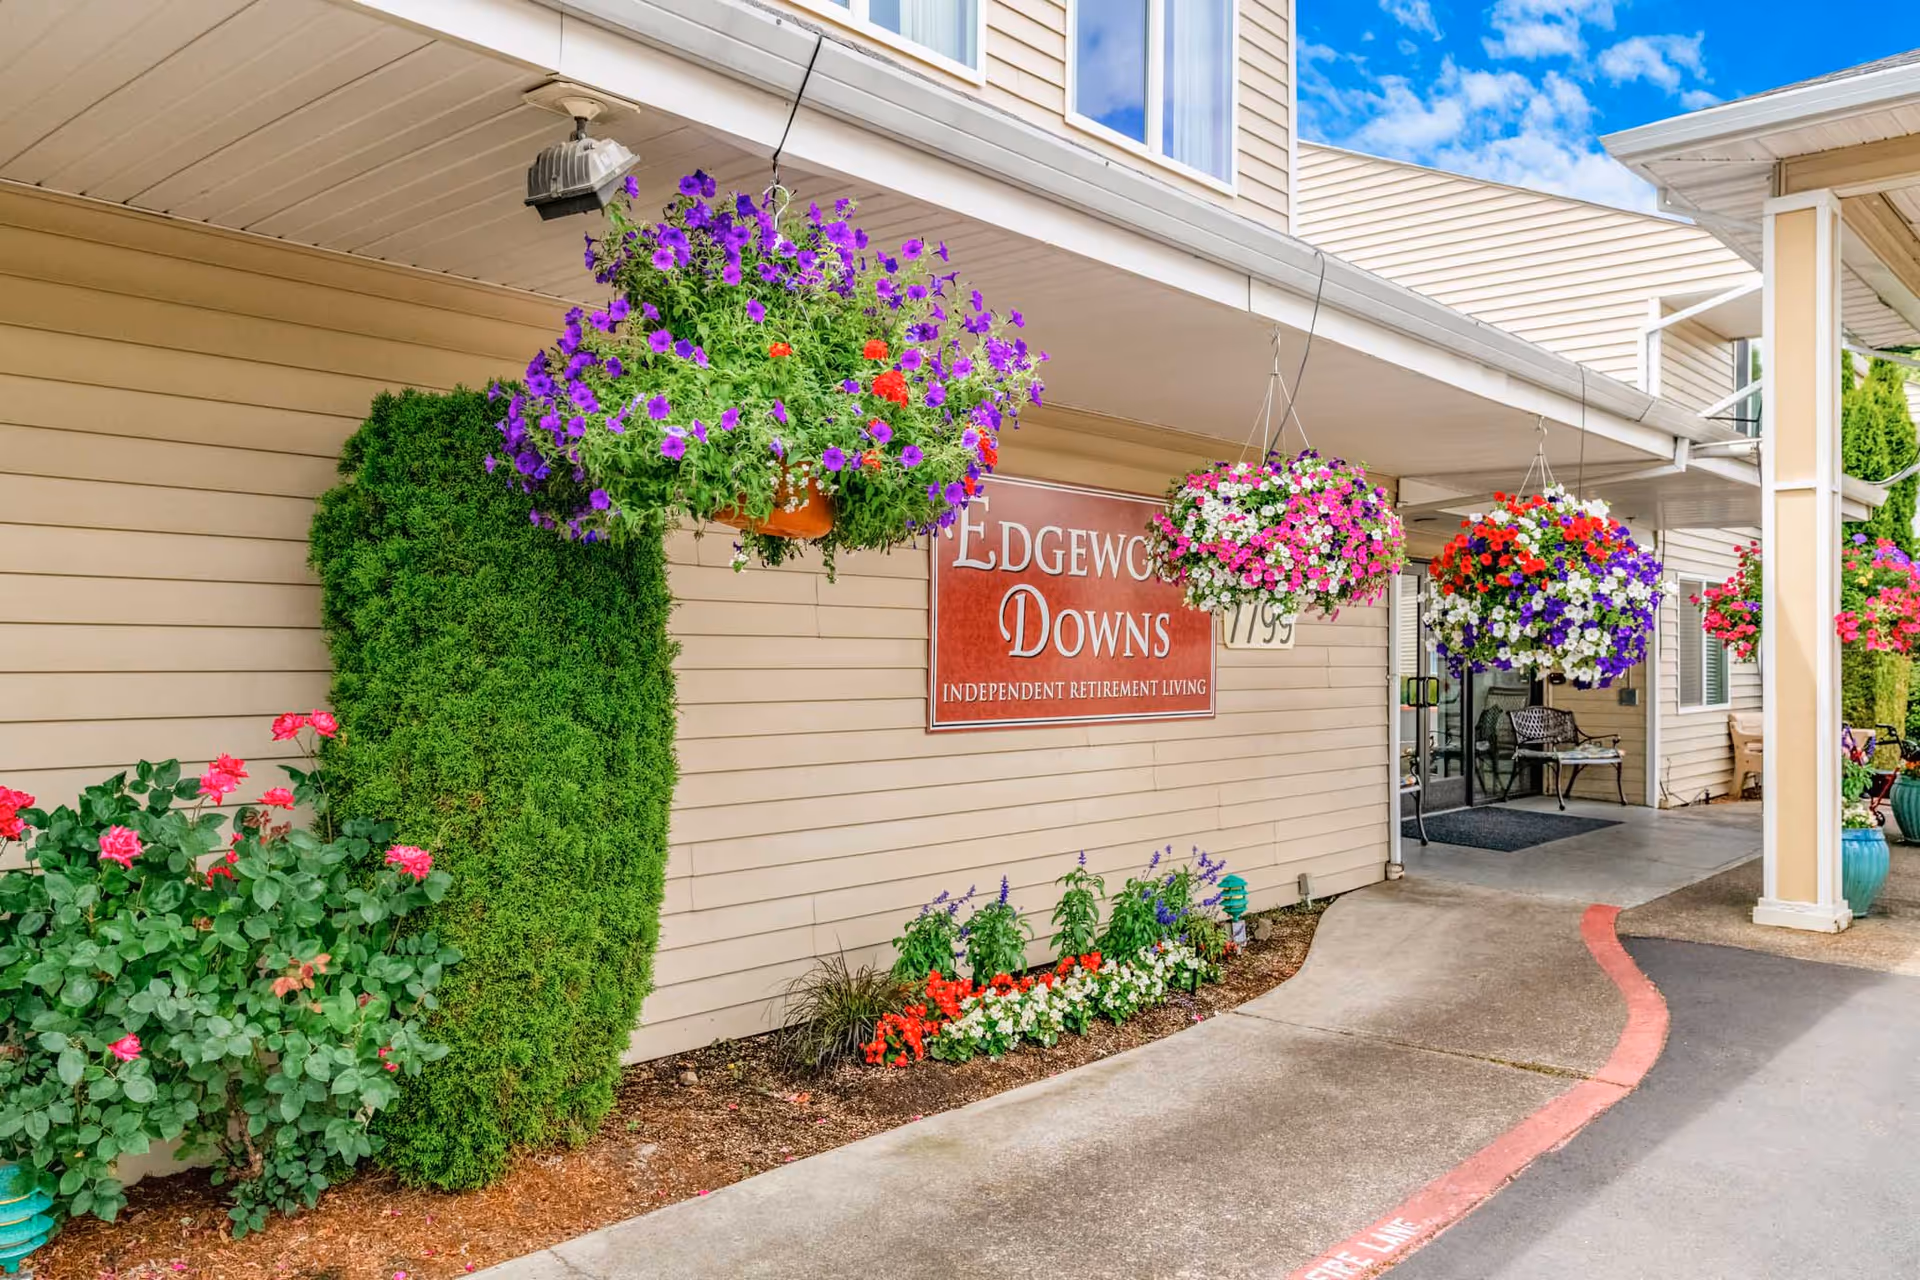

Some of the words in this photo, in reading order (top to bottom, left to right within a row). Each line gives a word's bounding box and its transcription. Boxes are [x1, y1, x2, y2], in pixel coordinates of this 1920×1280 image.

[943, 495, 1153, 581] EDGEWO
[999, 584, 1170, 659] DOWNS
[943, 681, 1065, 702] INDEPENDENT
[1070, 679, 1158, 699] RETIREMENT
[1162, 679, 1207, 696] LIVING
[1357, 1217, 1421, 1253] LANE
